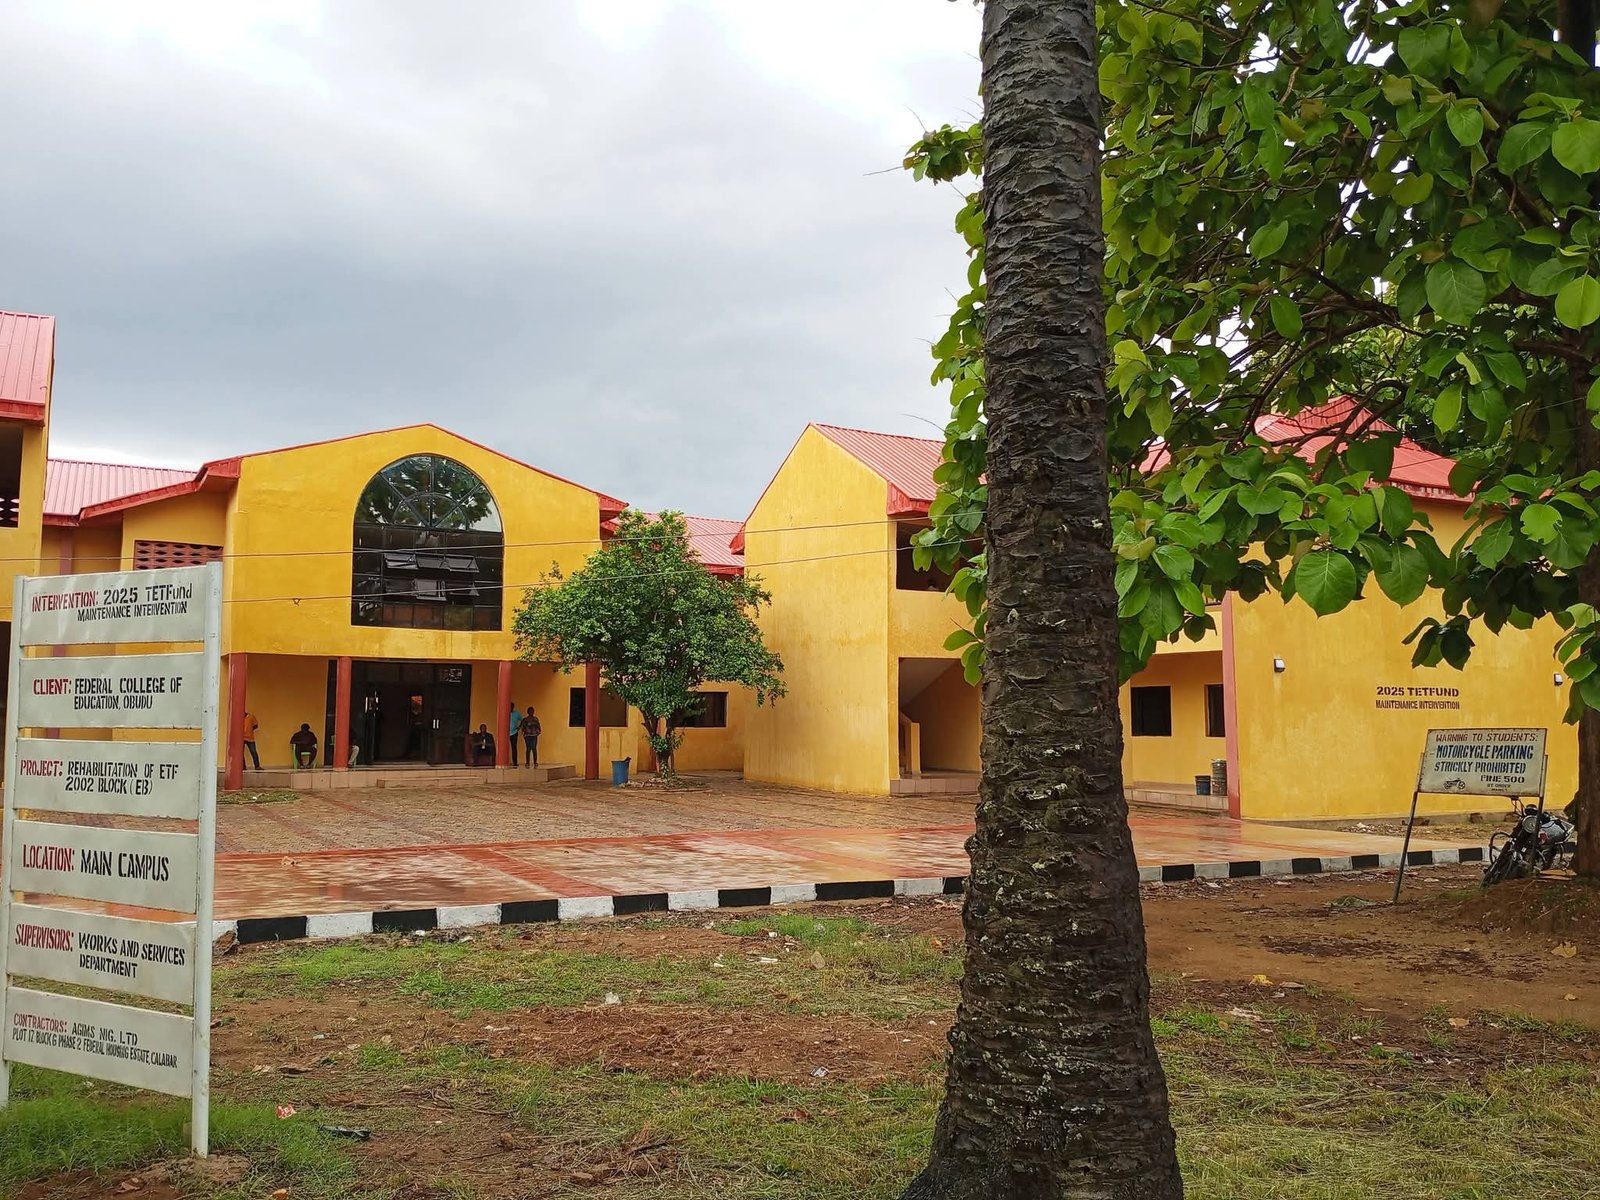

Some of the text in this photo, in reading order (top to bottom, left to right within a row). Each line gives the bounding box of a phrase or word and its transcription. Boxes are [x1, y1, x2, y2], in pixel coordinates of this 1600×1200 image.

[32, 583, 192, 612] INTERVENTION: 2025 TETFund
[77, 601, 188, 622] MAINTENANCE INTERVENTION
[33, 677, 183, 695] CLIENT: FEDERAL COLLEGE OF
[1376, 686, 1459, 697] 2025 TETFUND
[123, 695, 153, 709] OBUDU
[1376, 700, 1460, 710] MAINTENANCE INTERVENTION
[1436, 733, 1538, 742] WARNING TO STUDENTS:
[1436, 745, 1534, 759] MOTORCYCLE PARKING
[20, 759, 179, 779] PROJECT: REHABILITATION OF ETF
[1434, 761, 1526, 774] STRICKLY PROHIBITED
[65, 777, 153, 795] 2002 BLOCK (EB)
[1480, 775, 1525, 783] FINE 500
[23, 844, 169, 882] LOCATION: MAIN CAMPUS
[15, 924, 186, 966] SUPERVISORS: WORKS AND SERVICES
[79, 954, 138, 978] DEPARTMENT
[14, 1013, 138, 1046] CONTRACTORS: AGIMS NIG. LTD
[12, 1027, 27, 1041] PLOT
[36, 1031, 52, 1046] BLOCK
[58, 1034, 76, 1050] PHASE
[77, 1038, 82, 1050] 2
[83, 1038, 105, 1055] FEDERAL
[106, 1042, 129, 1059] HOUSING
[151, 1052, 178, 1068] CALABAR
